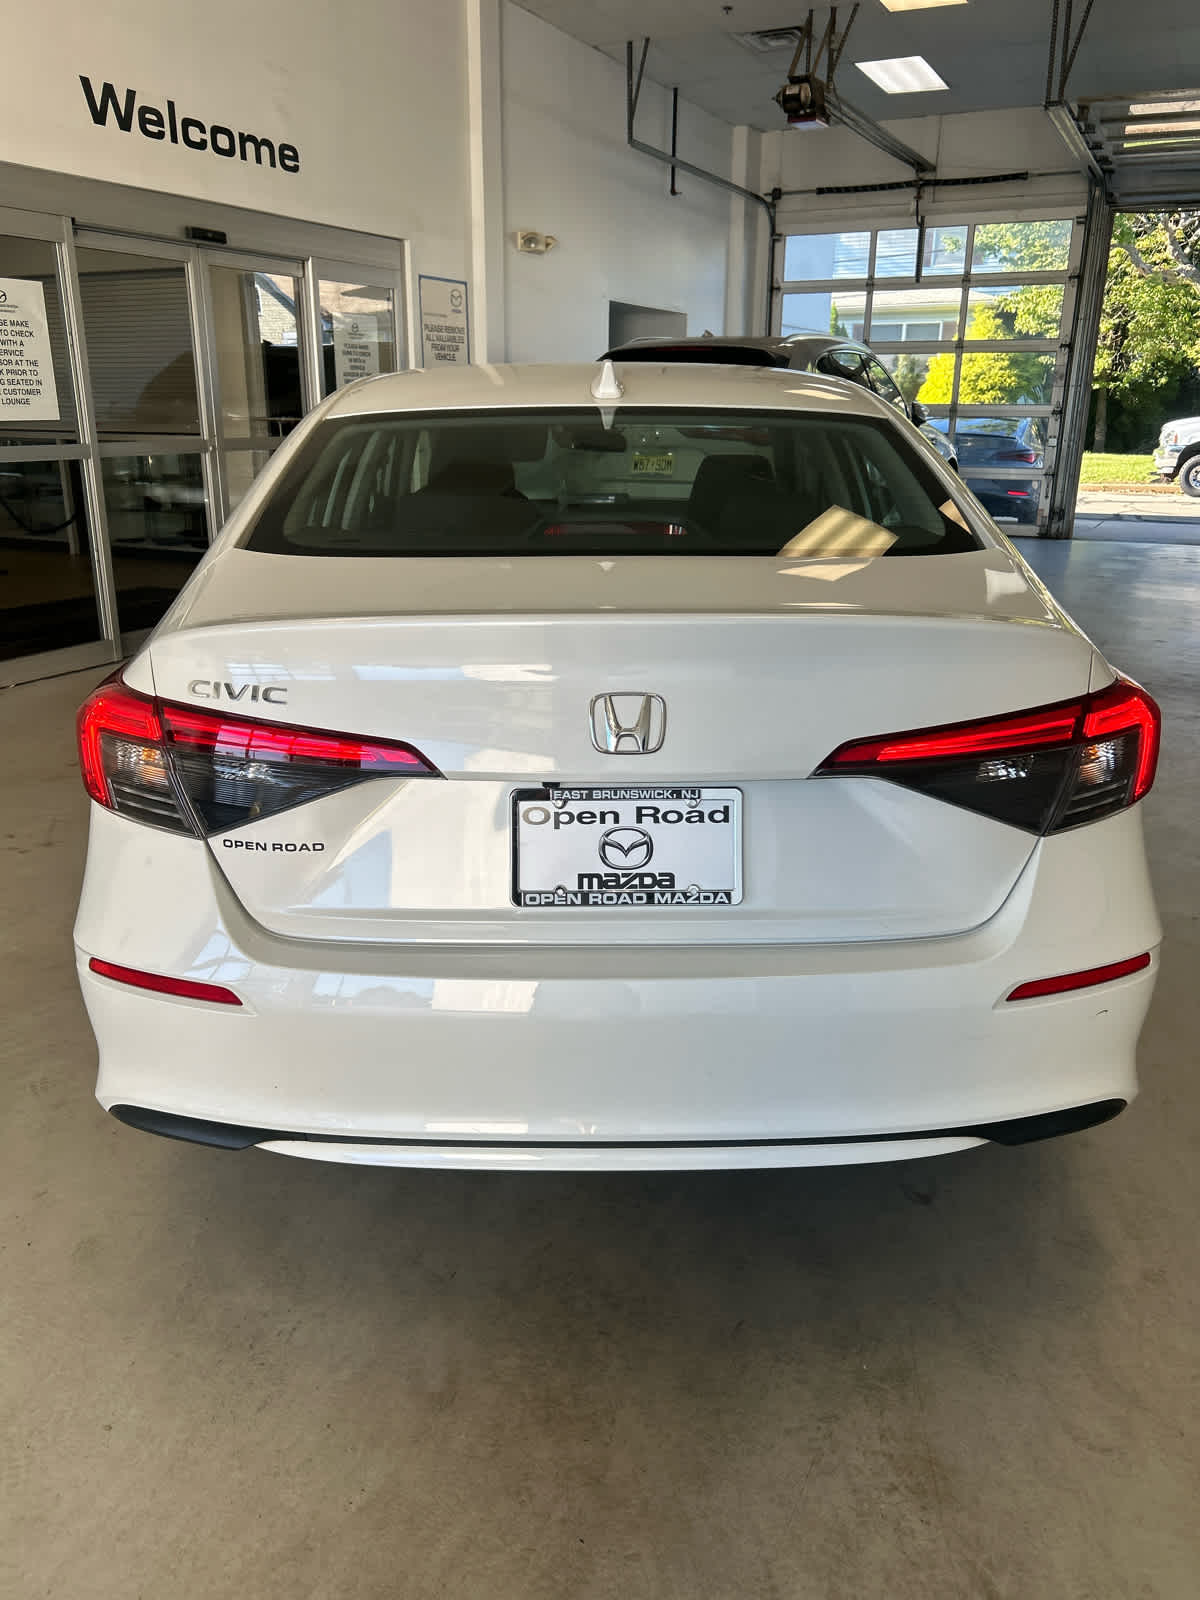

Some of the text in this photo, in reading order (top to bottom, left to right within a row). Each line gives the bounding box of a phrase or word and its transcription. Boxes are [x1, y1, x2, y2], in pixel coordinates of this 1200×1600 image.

[79, 75, 300, 173] Welcome
[9, 320, 30, 328] MAKE
[10, 329, 35, 338] CHECK
[29, 369, 38, 377] TO
[6, 378, 34, 386] SEATED
[3, 388, 41, 396] CUSTOMER
[190, 679, 288, 705] CIVIC
[553, 791, 588, 799] EAST
[680, 790, 700, 800] NJ
[522, 805, 730, 829] Open Road
[223, 839, 325, 852] OPEN ROAD
[577, 872, 676, 890] mazda
[525, 892, 729, 904] OPEN ROAD MAZDA
